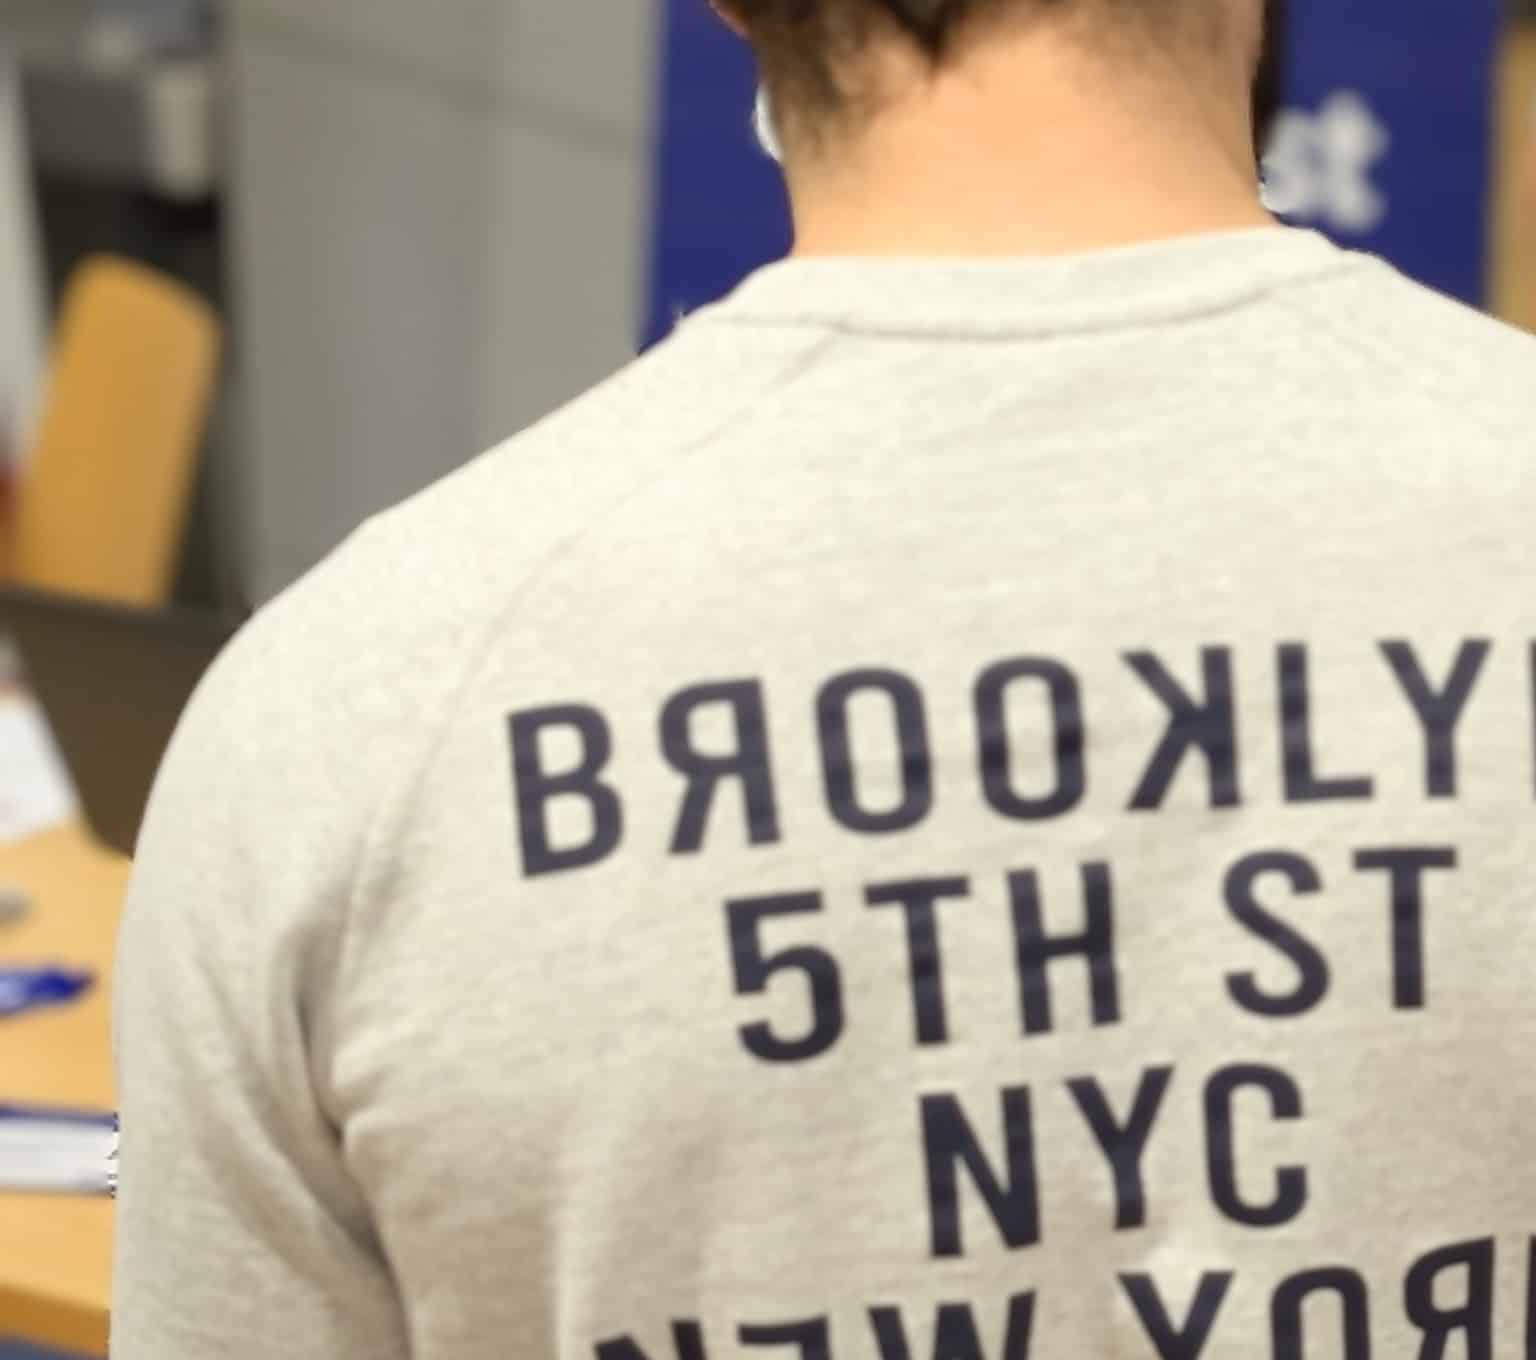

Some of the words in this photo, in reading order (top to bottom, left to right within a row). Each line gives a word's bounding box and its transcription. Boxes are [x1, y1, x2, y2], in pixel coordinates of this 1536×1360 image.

[725, 862, 1120, 1064] 5TH
[1224, 847, 1456, 1018] ST
[920, 1063, 1308, 1259] NYC
